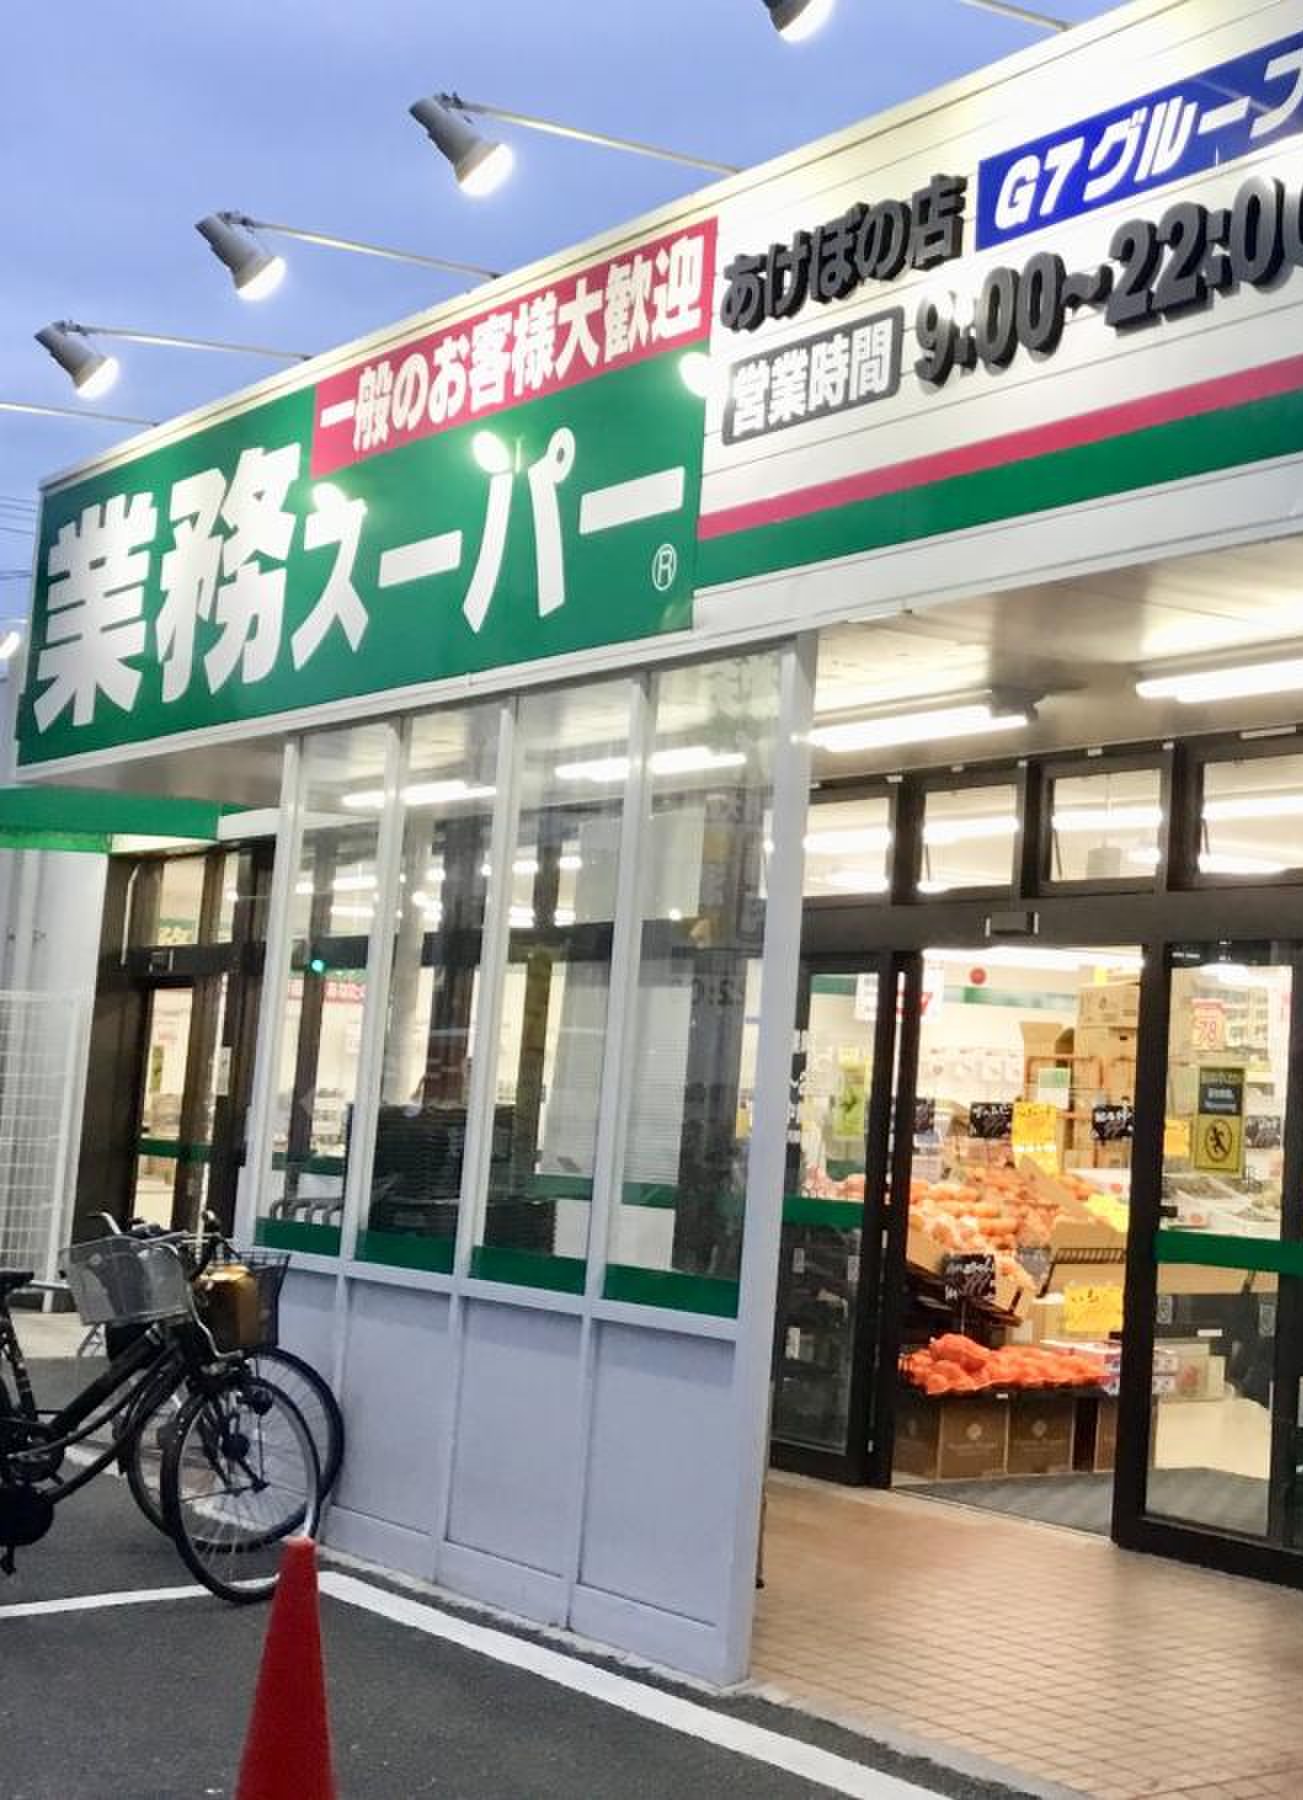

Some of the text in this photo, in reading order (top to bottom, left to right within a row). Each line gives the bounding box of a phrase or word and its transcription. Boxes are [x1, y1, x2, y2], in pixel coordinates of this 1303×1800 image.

[319, 235, 706, 450] 一般のお客様大歓迎
[720, 173, 968, 331] あけぼの店
[731, 316, 893, 438] 営業時間
[33, 427, 686, 733] 業務スーパー
